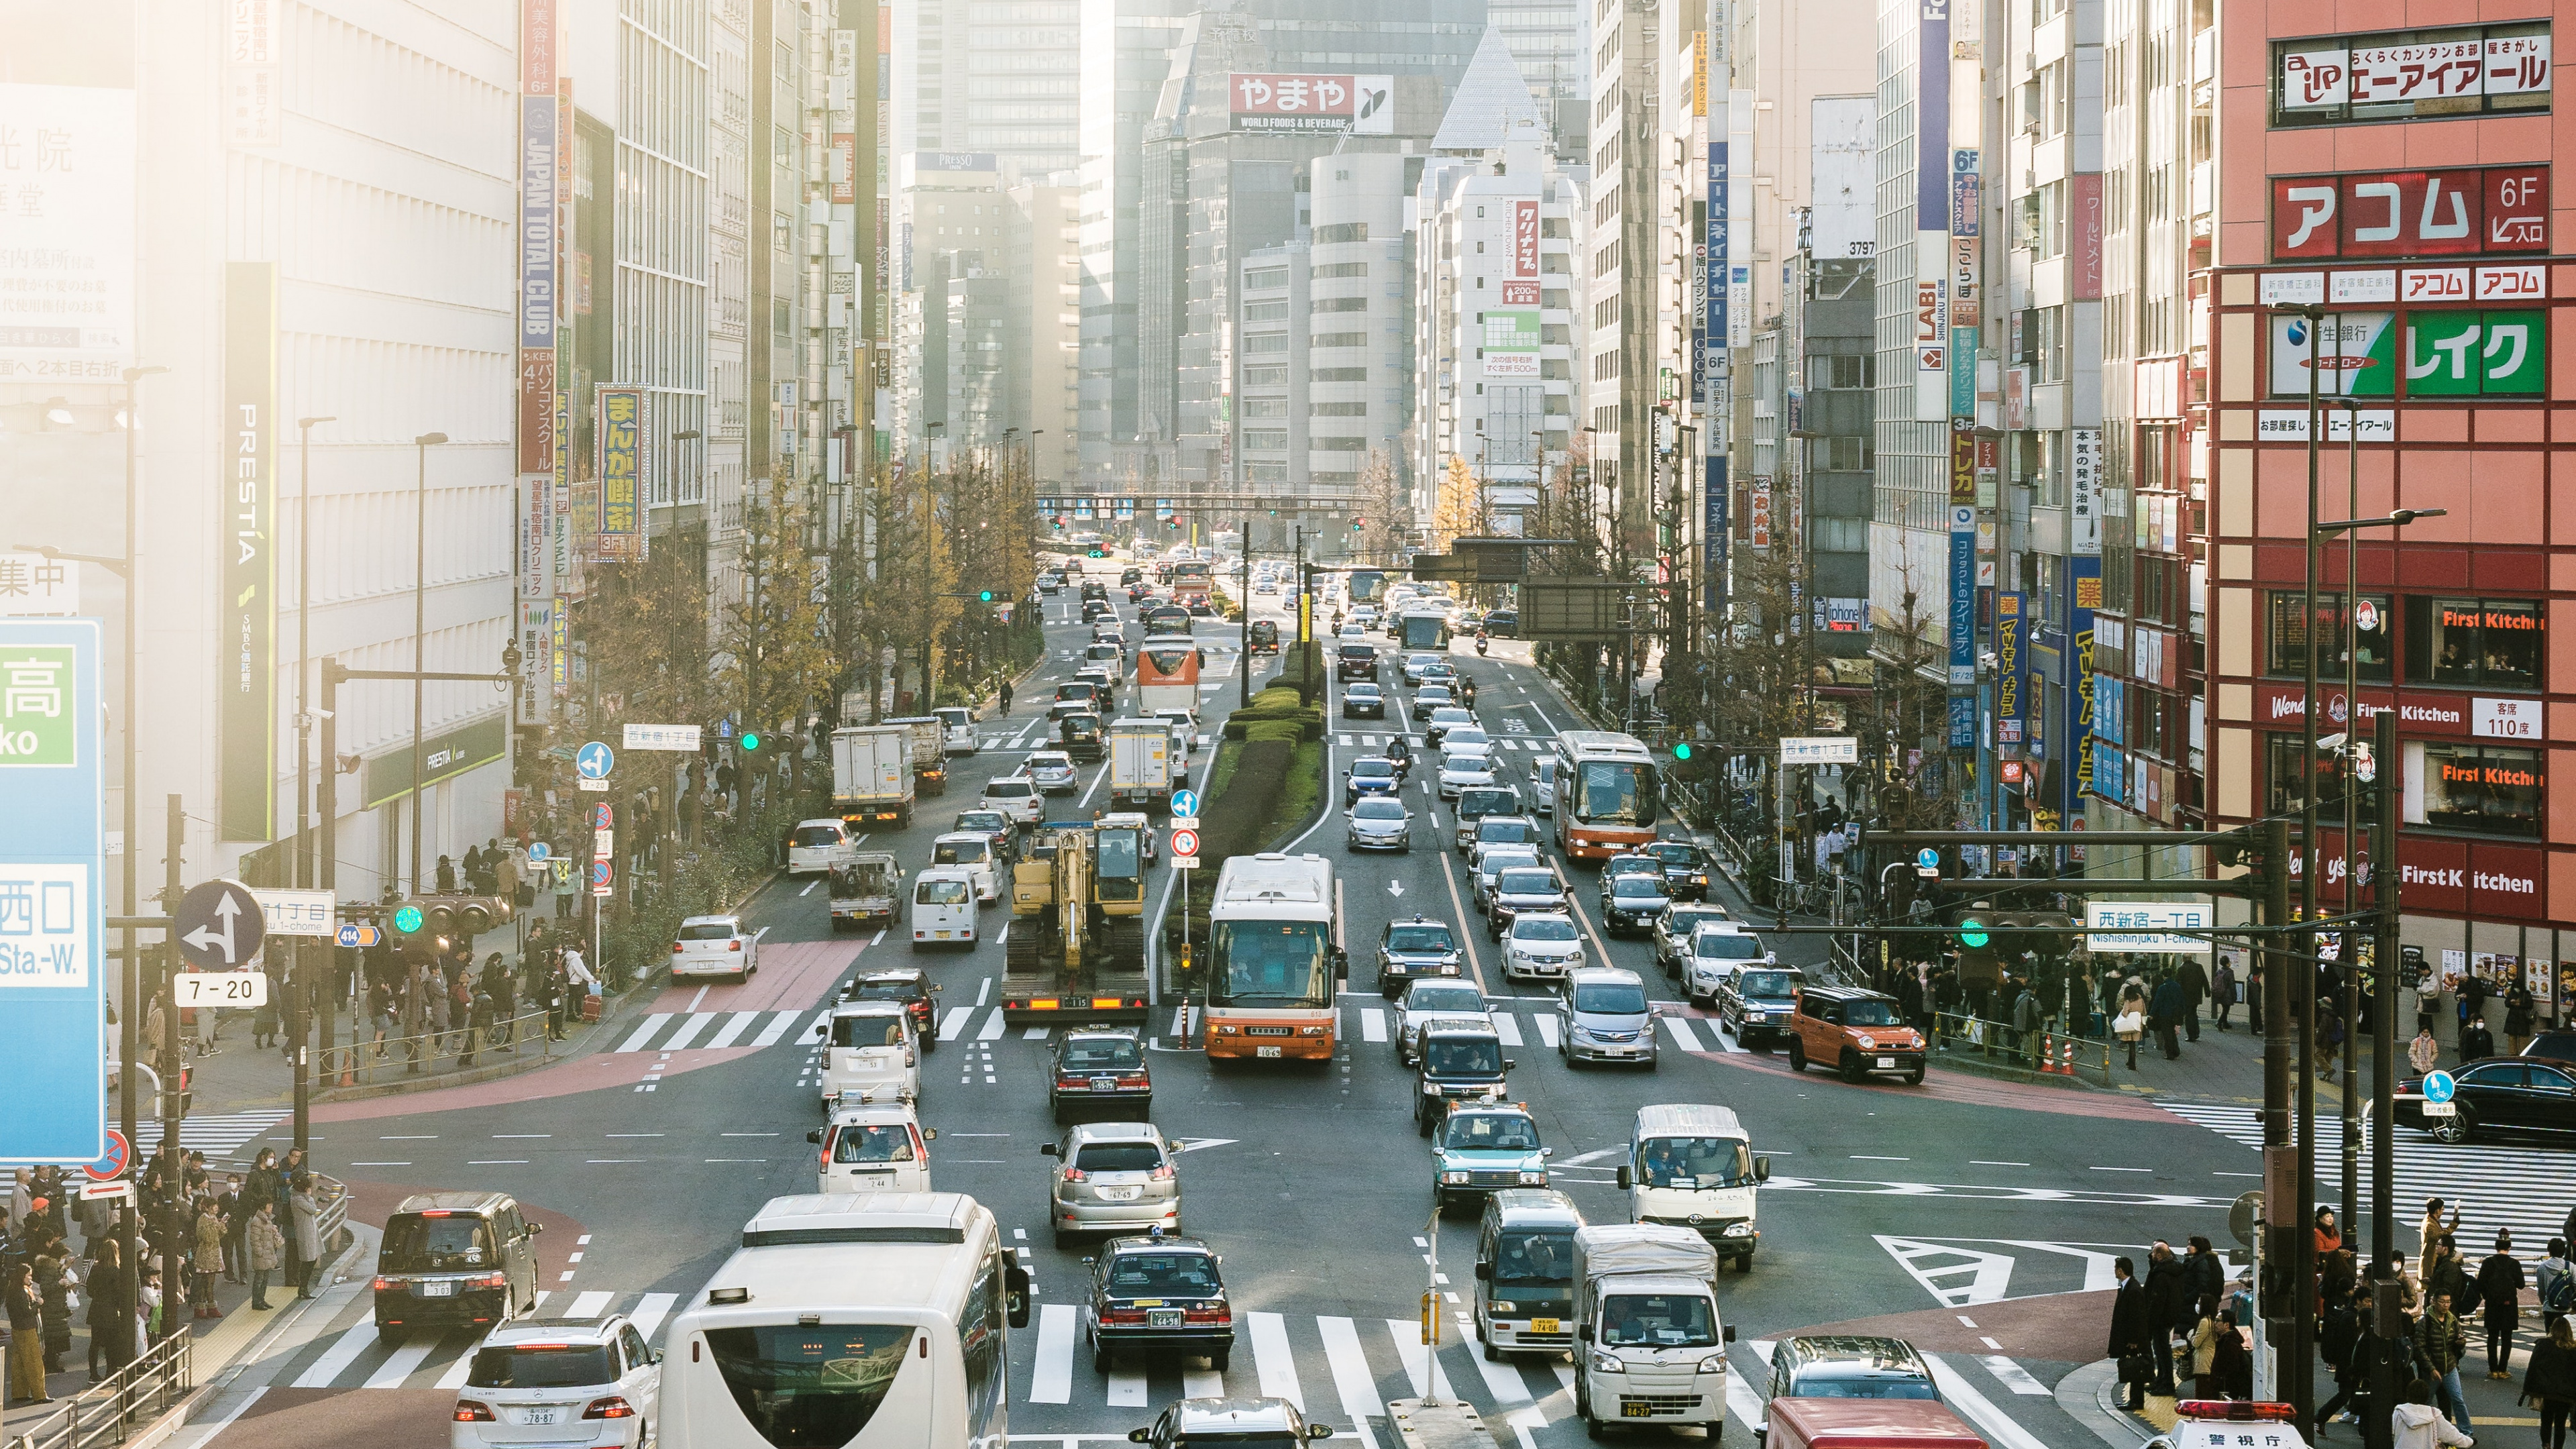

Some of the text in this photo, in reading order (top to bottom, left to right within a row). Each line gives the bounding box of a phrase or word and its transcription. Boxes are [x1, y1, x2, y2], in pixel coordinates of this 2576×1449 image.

[253, 0, 268, 62] 星新宿南口
[2352, 40, 2538, 65] らくらくカンタンお部屋さがし
[531, 82, 548, 93] 6F
[2352, 56, 2546, 100] エーアイアール
[1239, 78, 1345, 111] やまや
[879, 102, 887, 145] KASHIWA
[1241, 117, 1346, 129] WORLD FOODS & BEVERAGE
[939, 153, 972, 166] PRESSO
[1954, 150, 1978, 171] 6F
[527, 138, 551, 208] JAPAN
[2501, 177, 2537, 207] 6F
[1505, 200, 1513, 232] KITCHEN
[2288, 178, 2469, 248] アコム
[526, 213, 550, 276] TOTAL
[1505, 234, 1513, 257] TOWN
[1519, 209, 1536, 270] クリナップ
[2087, 197, 2098, 283] ワールドメイト
[2516, 225, 2543, 243] 入口
[1849, 241, 1875, 255] 3797
[1514, 286, 1538, 296] 200m
[2410, 274, 2463, 297] アコム
[2484, 272, 2538, 294] アコム
[526, 280, 550, 335] CLUB
[1919, 282, 1936, 341] LABI
[1937, 302, 1945, 341] SHINJUKU
[1957, 314, 1972, 325] 5F
[533, 352, 553, 361] KEN
[1491, 356, 1533, 364] 次の信号右折
[1709, 357, 1725, 368] 6F
[2407, 325, 2528, 379] レイク
[879, 352, 887, 384] 山本ビル
[1486, 364, 1512, 372] すぐ左折
[537, 364, 552, 470] パソコンスクール
[1713, 389, 1721, 450] 日本デジタル研究所
[1954, 418, 1973, 431] 3F
[2261, 421, 2305, 431] お部屋探し
[608, 396, 635, 531] まんが喫茶
[1955, 435, 1973, 492] トレカ
[2076, 431, 2089, 515] 本気の発毛治療
[1695, 469, 1704, 508] SoftBank
[531, 480, 542, 596] 望星新宿南口クリニック
[1957, 541, 1969, 657] コンタクトのアイシティ
[2002, 597, 2017, 614] 薬
[2078, 582, 2101, 606] 薬
[1814, 600, 1825, 627] 新宿
[1829, 603, 1858, 622] iphone
[2443, 612, 2479, 627] First
[240, 614, 251, 692] SMBC信託銀行
[539, 632, 548, 673] 人間ドック
[525, 630, 535, 720] 新宿ロイヤル診療所
[2001, 619, 2018, 716] マツモトキヨシ
[3, 657, 62, 717] 高
[2401, 705, 2460, 724] Kitchen
[2498, 702, 2516, 716] 客席
[1952, 704, 1961, 746] アイ眼科
[1962, 699, 1972, 743] 新宿南口
[2489, 719, 2529, 736] 110席
[629, 731, 695, 742] 西新宿1丁目
[1999, 732, 2017, 741] 免税
[1786, 745, 1853, 755] 西新宿1丁目
[2443, 765, 2479, 782] First
[2402, 865, 2445, 886] First
[280, 921, 322, 931] 1-chome
[2100, 912, 2200, 928] 西新宿一丁目
[339, 930, 357, 942] 414
[2093, 933, 2158, 945] Nishishinjuku
[529, 1414, 553, 1423] 78-87
[1627, 1408, 1650, 1416] 84-27
[2209, 1434, 2281, 1446] 警視庁
